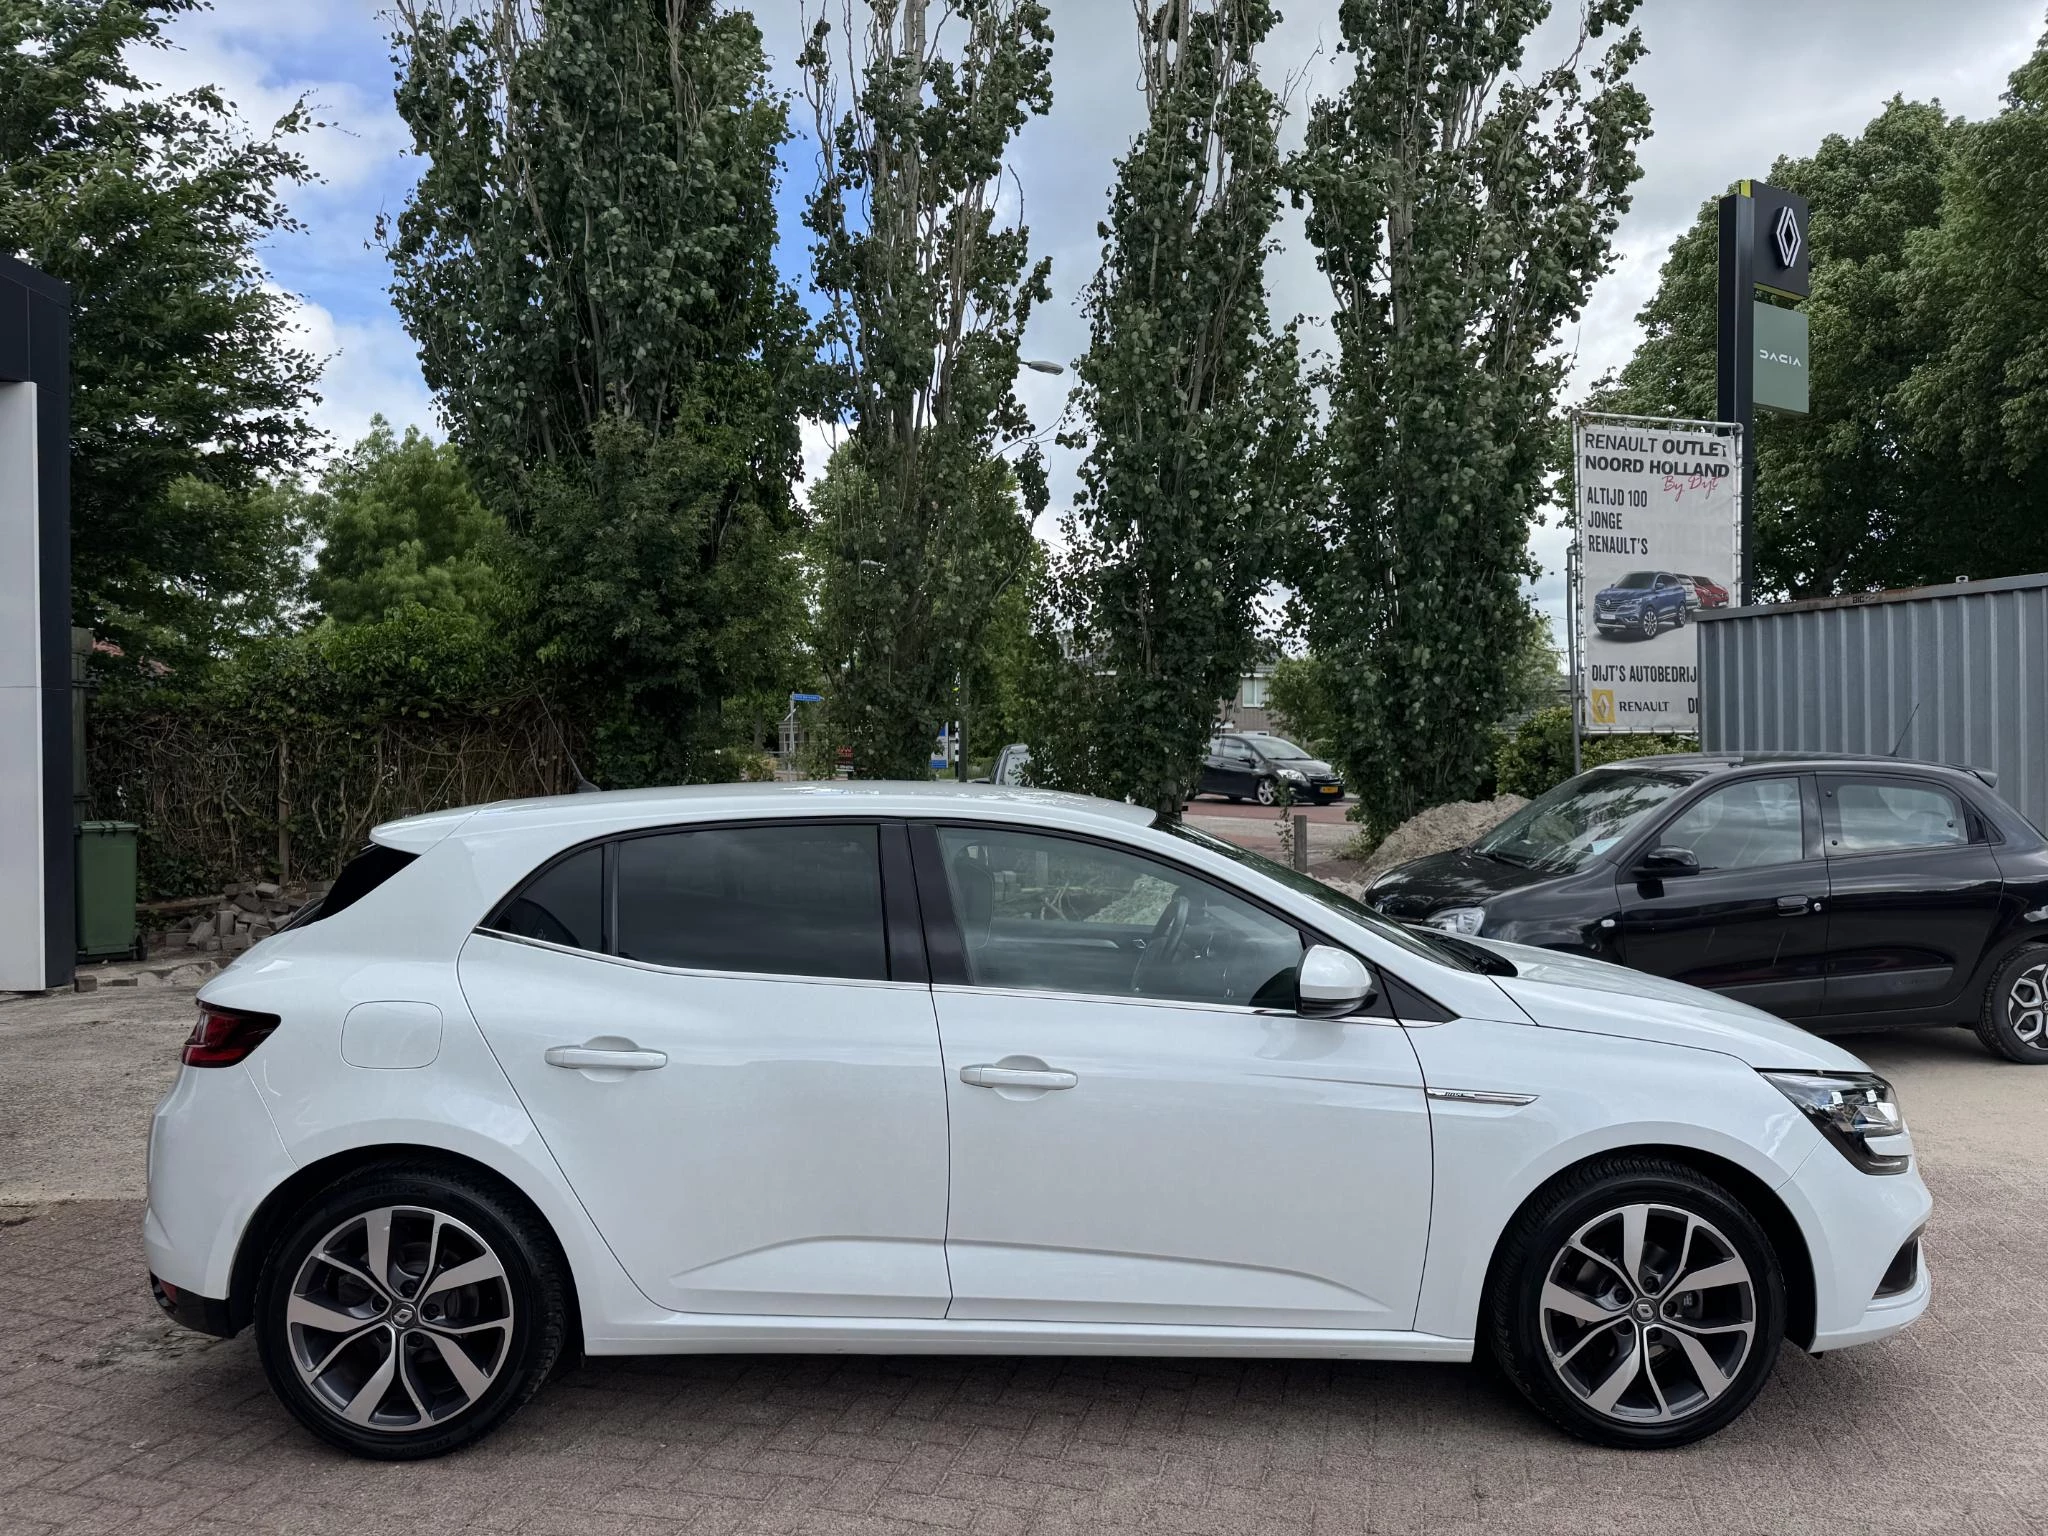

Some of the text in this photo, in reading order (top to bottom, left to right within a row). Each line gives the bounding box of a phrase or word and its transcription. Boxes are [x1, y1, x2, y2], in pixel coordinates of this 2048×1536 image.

[1759, 350, 1801, 367] DACIA
[1585, 433, 1727, 457] RENAULT OUTLET
[1585, 455, 1730, 478] NOORD HOLLAND
[1587, 486, 1647, 507] ALTIJD 100
[1663, 475, 1684, 502] By
[1588, 511, 1622, 530] JONGE
[1588, 535, 1648, 555] RENAULT'S
[1592, 664, 1697, 682] DIJT'S AUTOBEDRIJ
[1619, 701, 1670, 712] RENAULT
